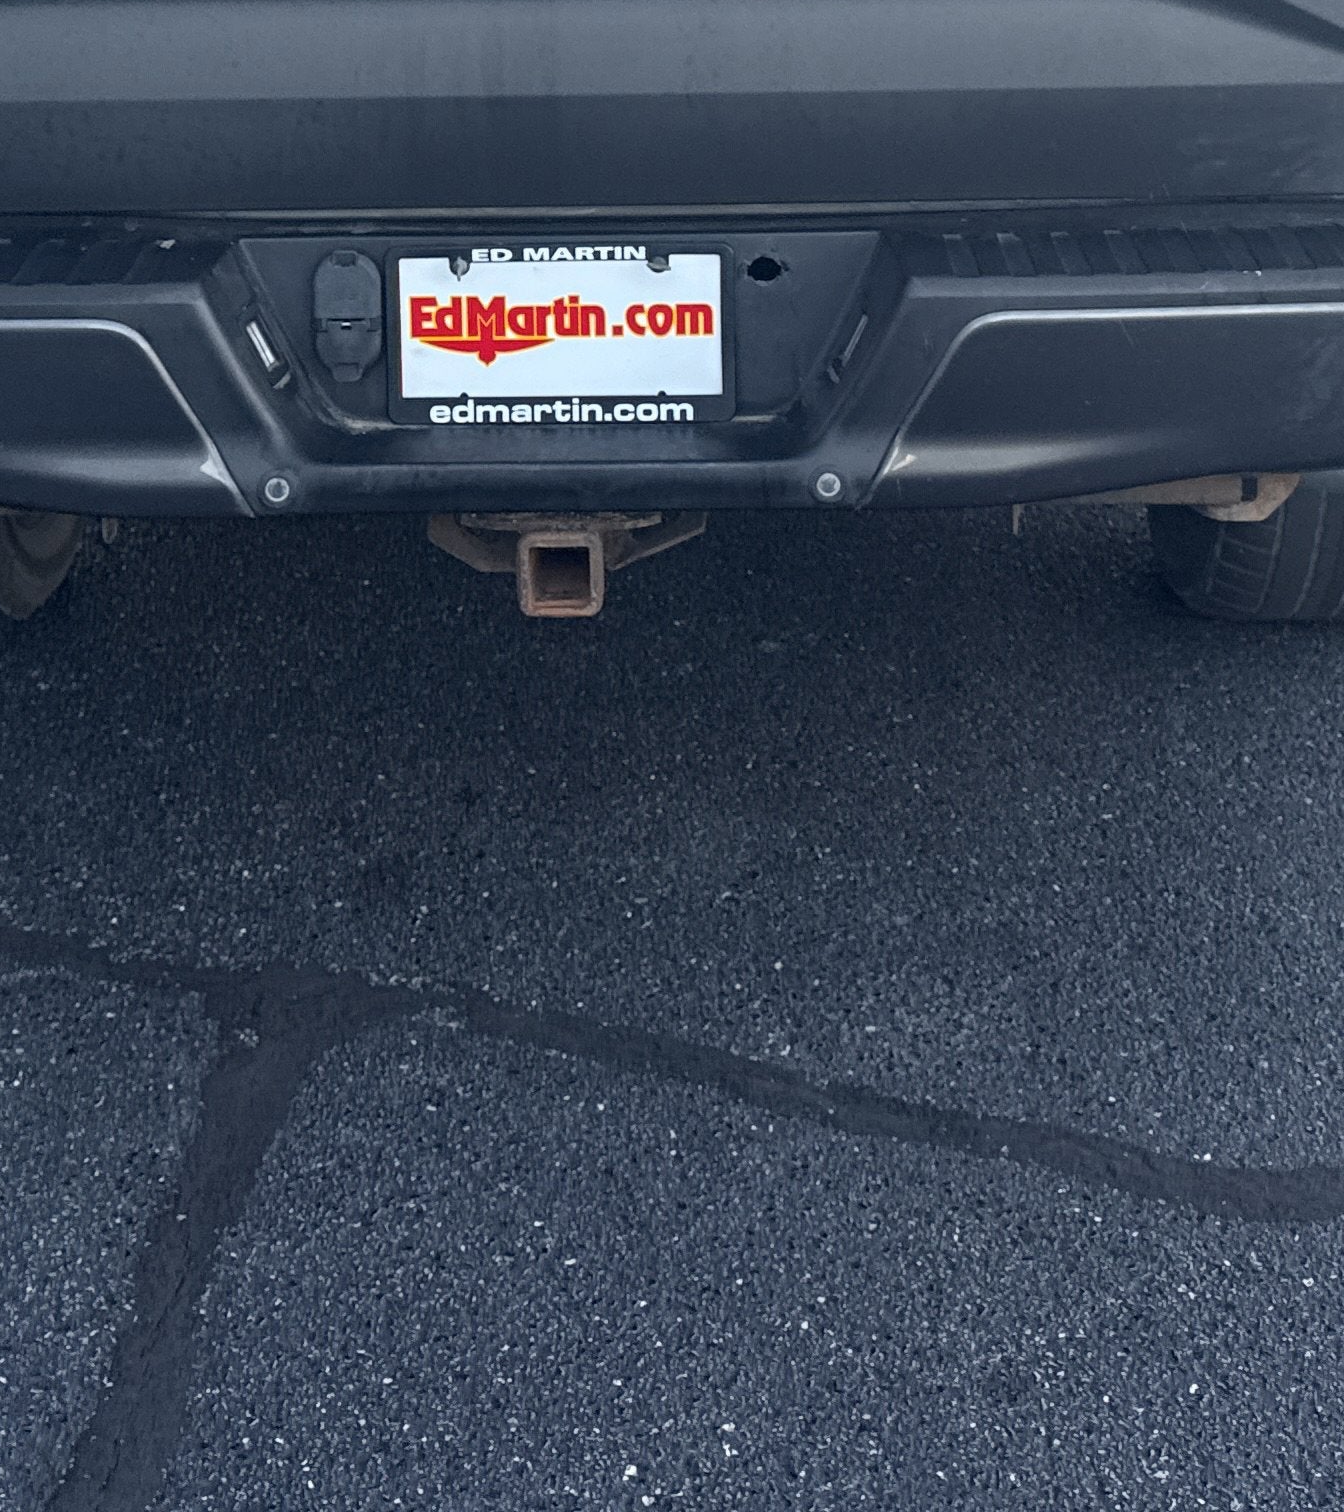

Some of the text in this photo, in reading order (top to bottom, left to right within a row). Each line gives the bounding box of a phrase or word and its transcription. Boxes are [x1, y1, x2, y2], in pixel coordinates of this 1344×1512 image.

[471, 246, 646, 262] ED MARTIN
[429, 398, 694, 424] edmartin.com
